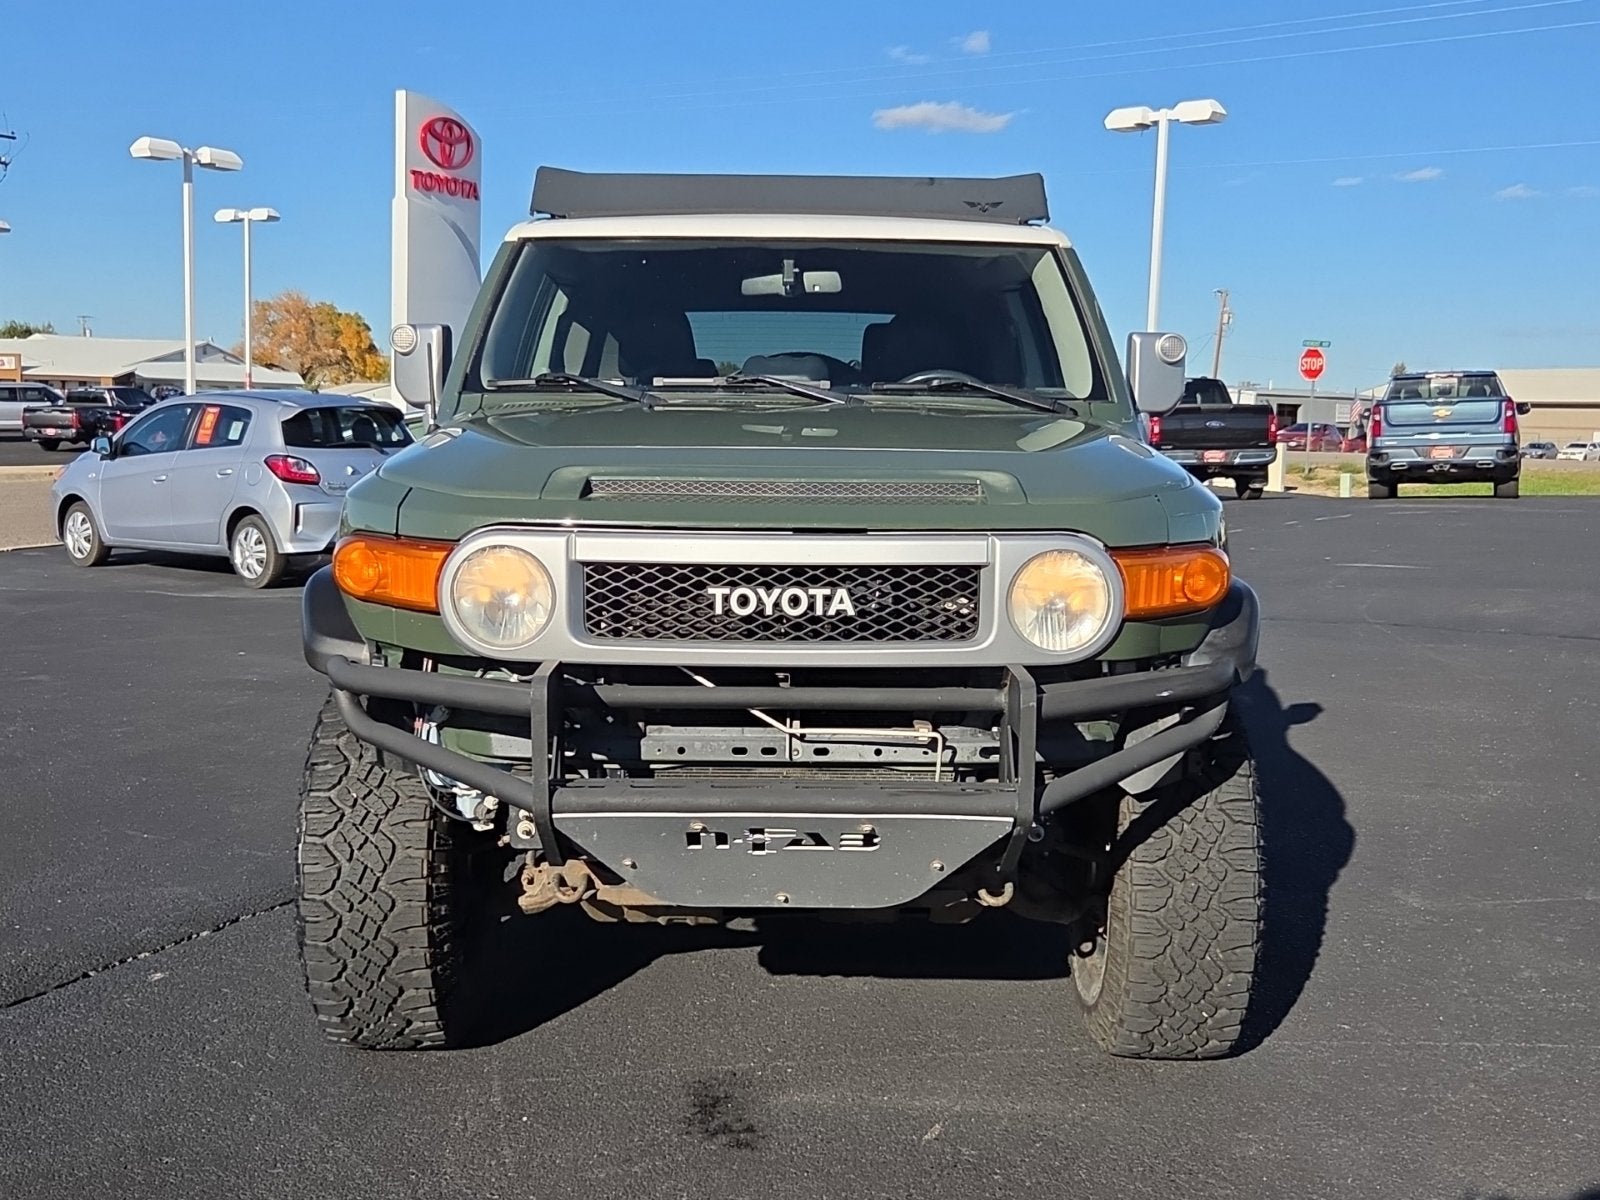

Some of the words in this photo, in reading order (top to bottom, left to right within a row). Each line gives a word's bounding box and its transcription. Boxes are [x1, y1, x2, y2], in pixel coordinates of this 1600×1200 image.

[410, 170, 480, 201] TOYOTA
[1301, 357, 1323, 371] STOP
[707, 587, 856, 617] TOYOTA
